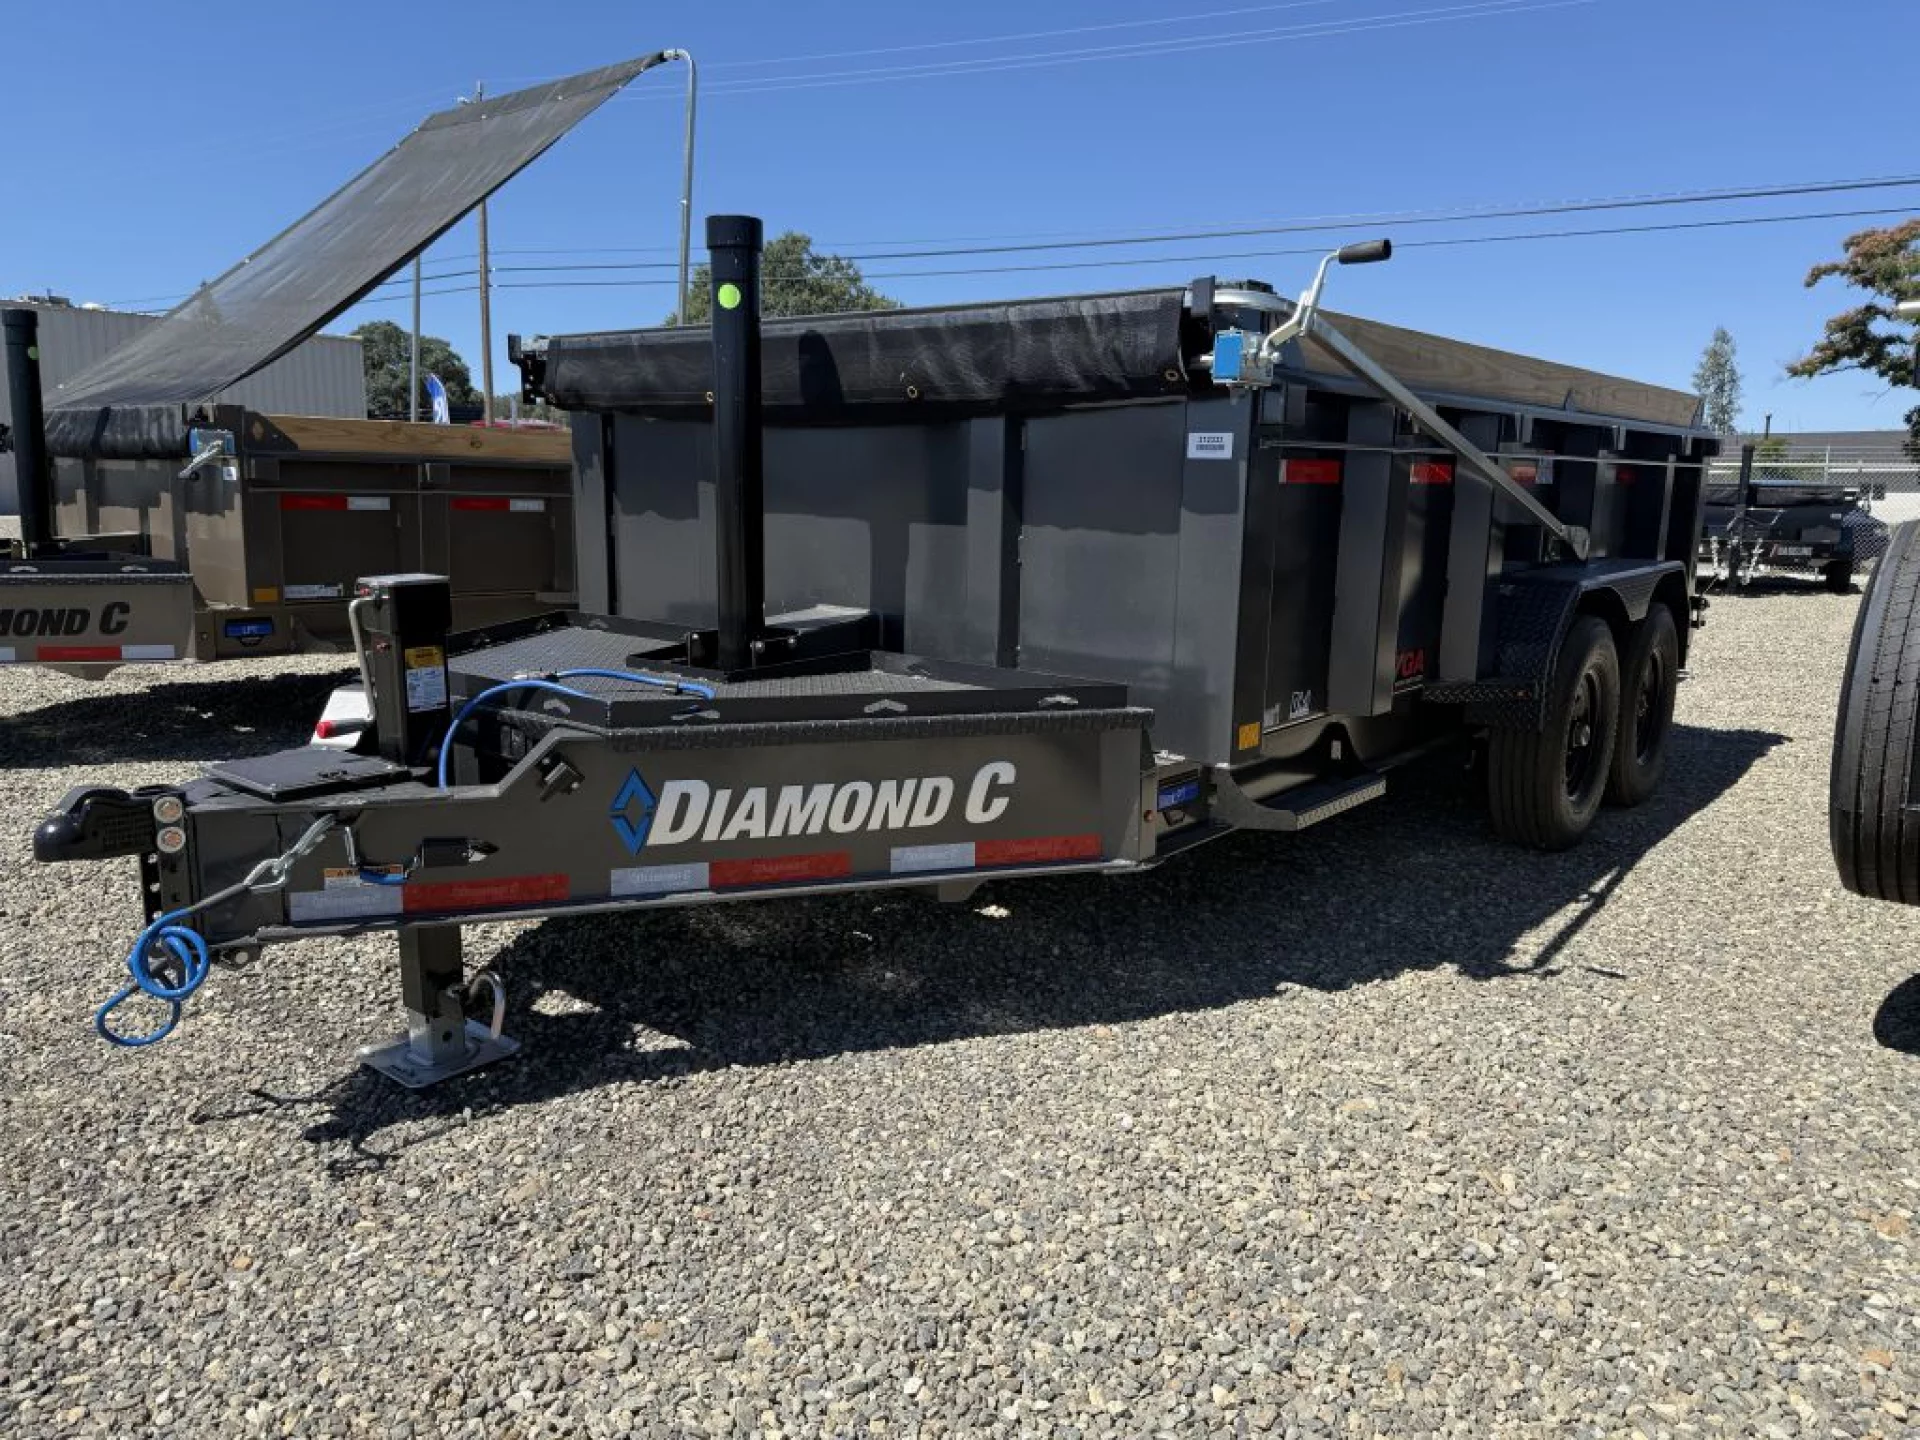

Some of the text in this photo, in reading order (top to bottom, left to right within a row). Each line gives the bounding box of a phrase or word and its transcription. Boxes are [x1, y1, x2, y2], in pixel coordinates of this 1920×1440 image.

[99, 601, 131, 635] C
[646, 760, 1017, 846] DIAMOND C
